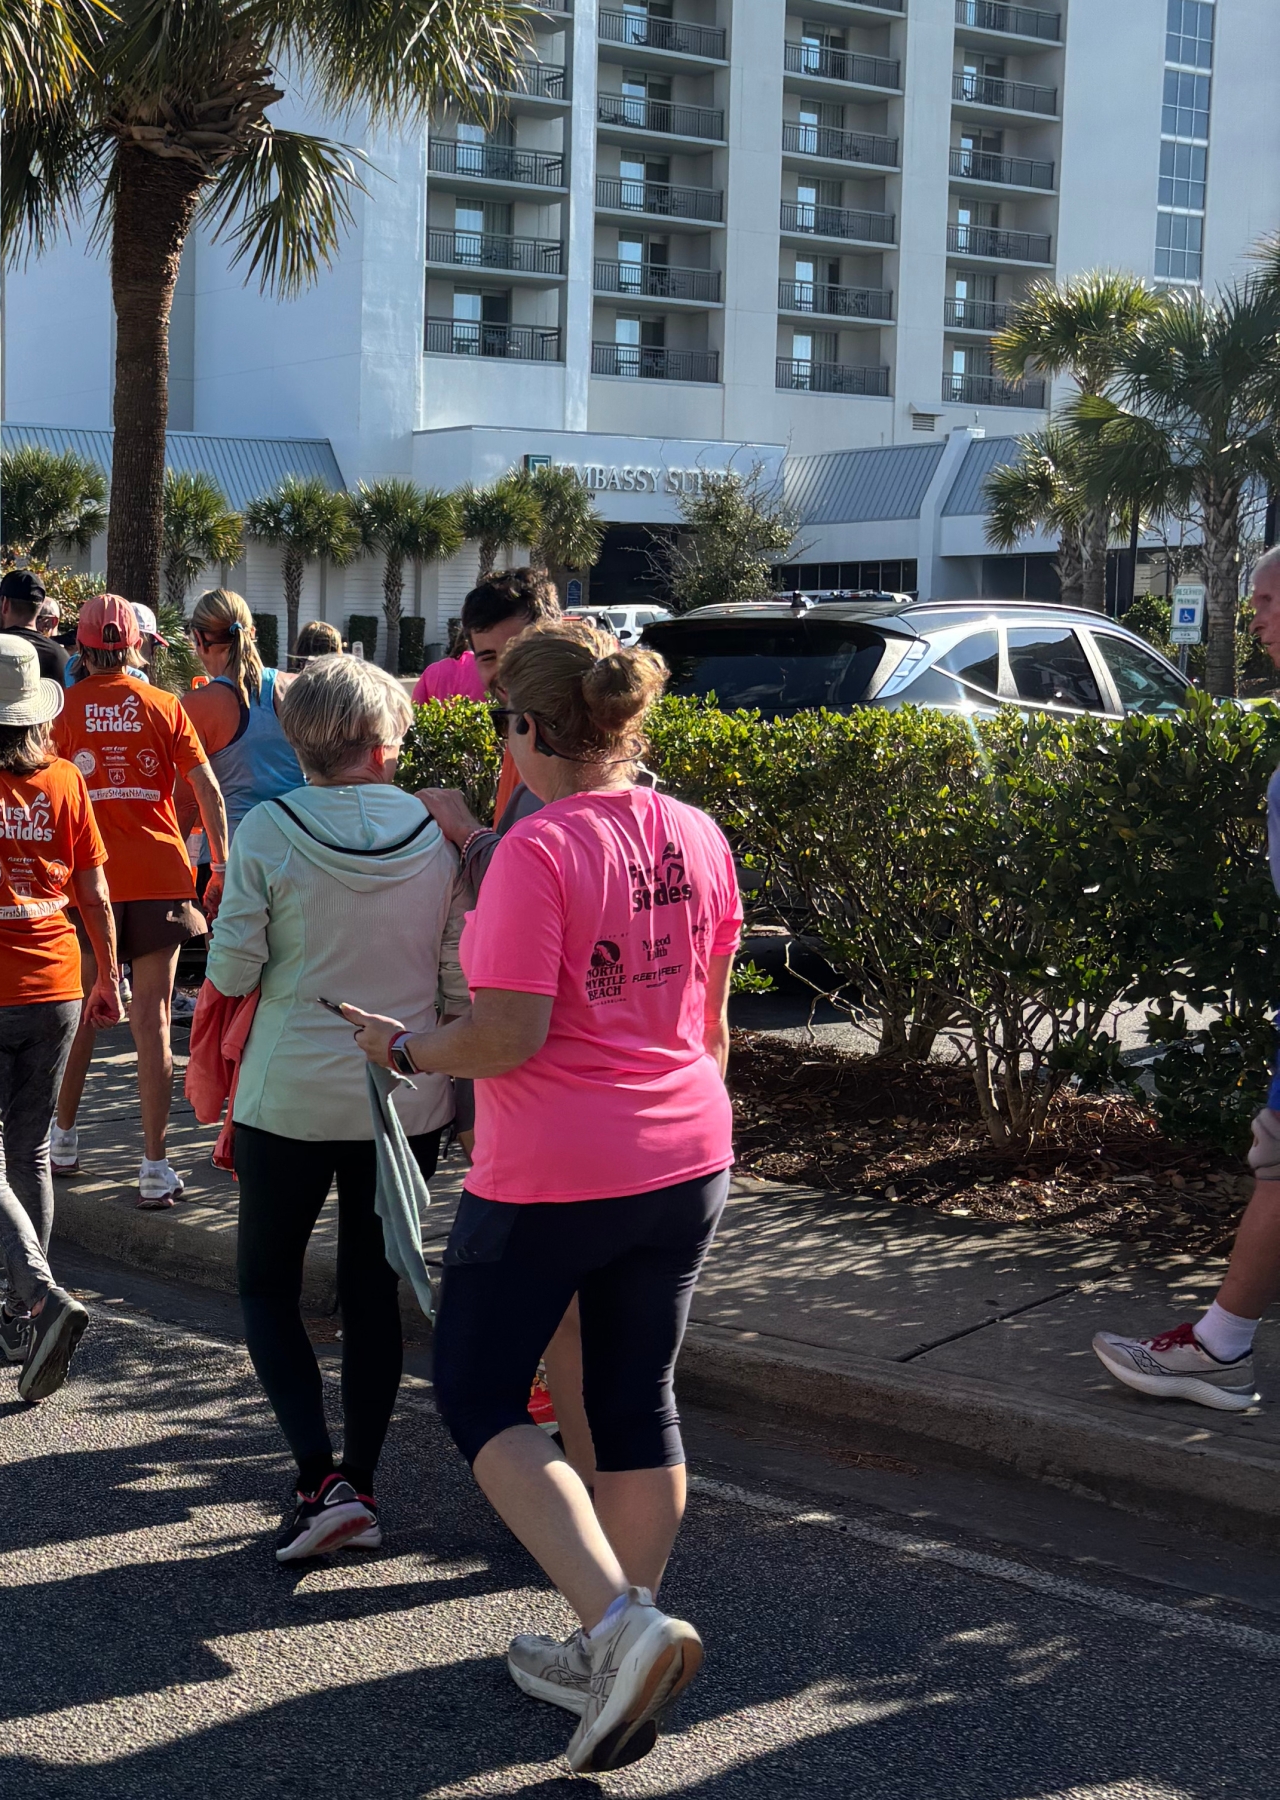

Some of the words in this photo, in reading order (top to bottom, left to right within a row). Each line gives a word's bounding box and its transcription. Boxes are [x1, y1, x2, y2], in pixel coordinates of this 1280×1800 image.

[85, 703, 121, 718] First
[85, 718, 142, 732] Strides
[632, 882, 693, 913] Stdes
[587, 964, 624, 979] NORTH
[661, 964, 683, 975] FEET
[585, 974, 627, 991] MYRTLE
[588, 985, 622, 1001] BEACH
